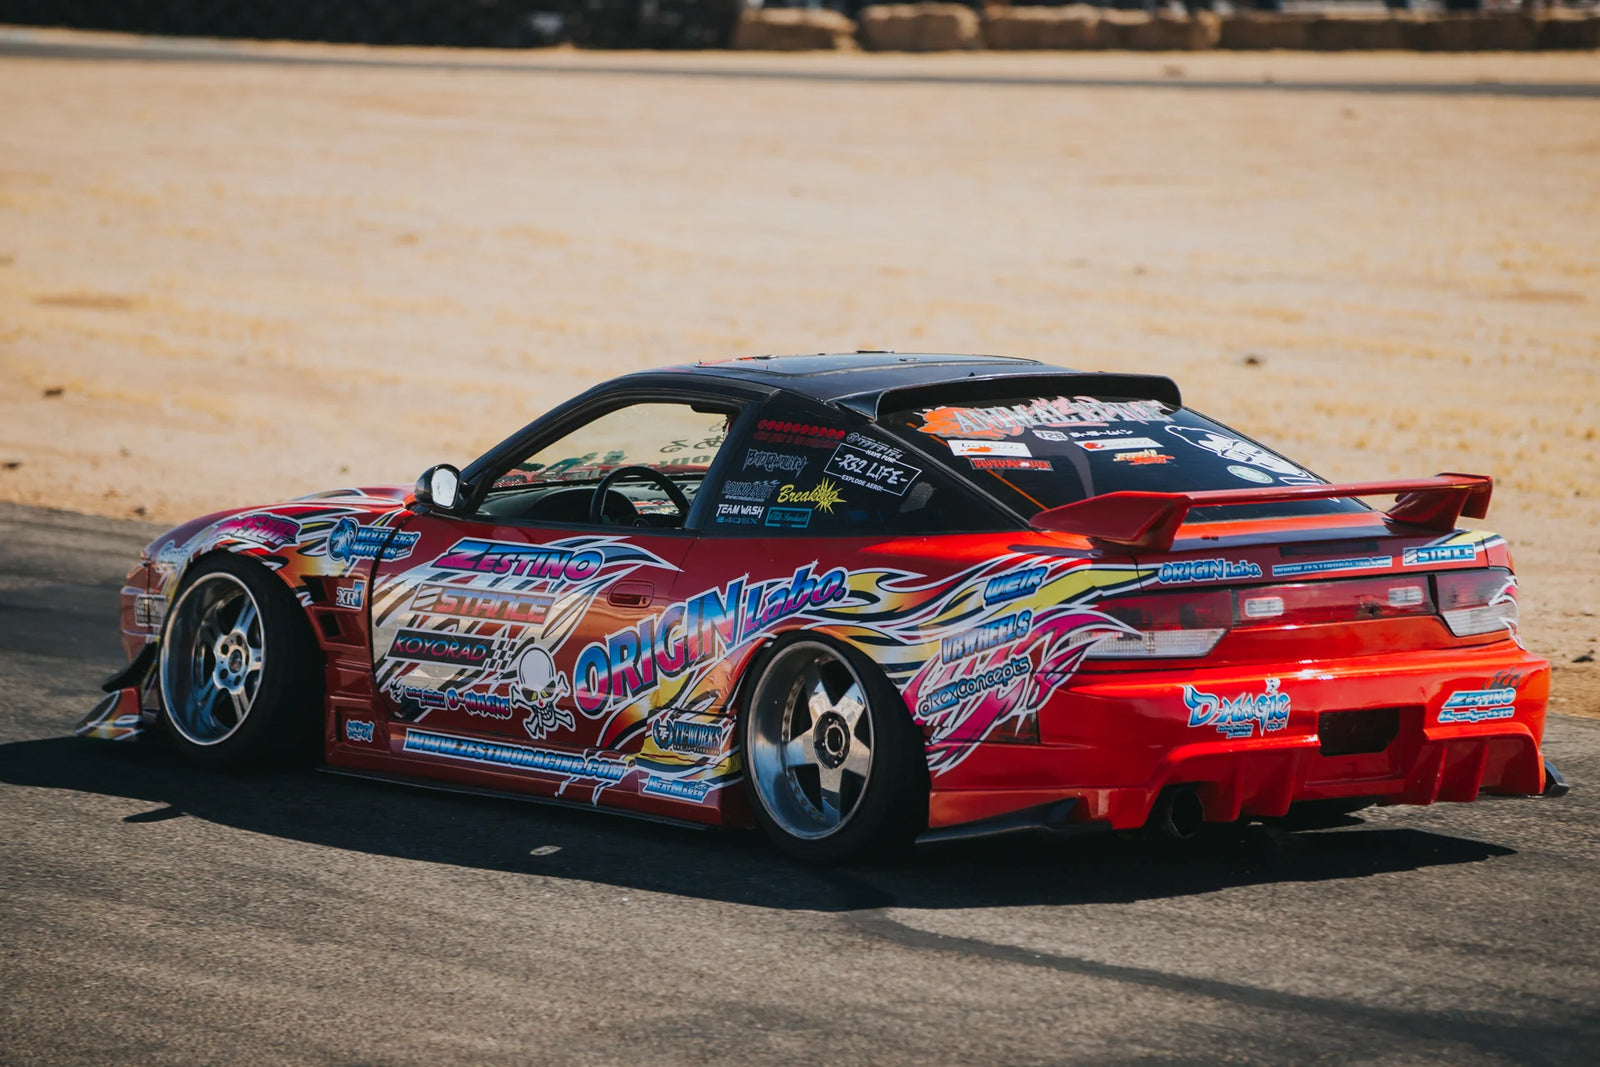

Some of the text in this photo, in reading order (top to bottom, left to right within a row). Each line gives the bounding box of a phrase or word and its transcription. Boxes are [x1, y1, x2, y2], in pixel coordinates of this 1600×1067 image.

[716, 503, 741, 517] TEAM
[741, 505, 764, 519] WASH
[431, 538, 604, 581] ZESTINO
[1417, 545, 1474, 562] STANCE
[984, 567, 1047, 600] WEIR
[1157, 559, 1225, 583] ORIGIN
[434, 587, 551, 622] STANCE
[393, 636, 487, 661] KOYORAD
[574, 565, 847, 716] ORIGIN Labo.
[1444, 688, 1516, 708] ZESTINO
[658, 726, 670, 741] TF
[405, 731, 627, 780] WWW.ZESTINORACING.COM
